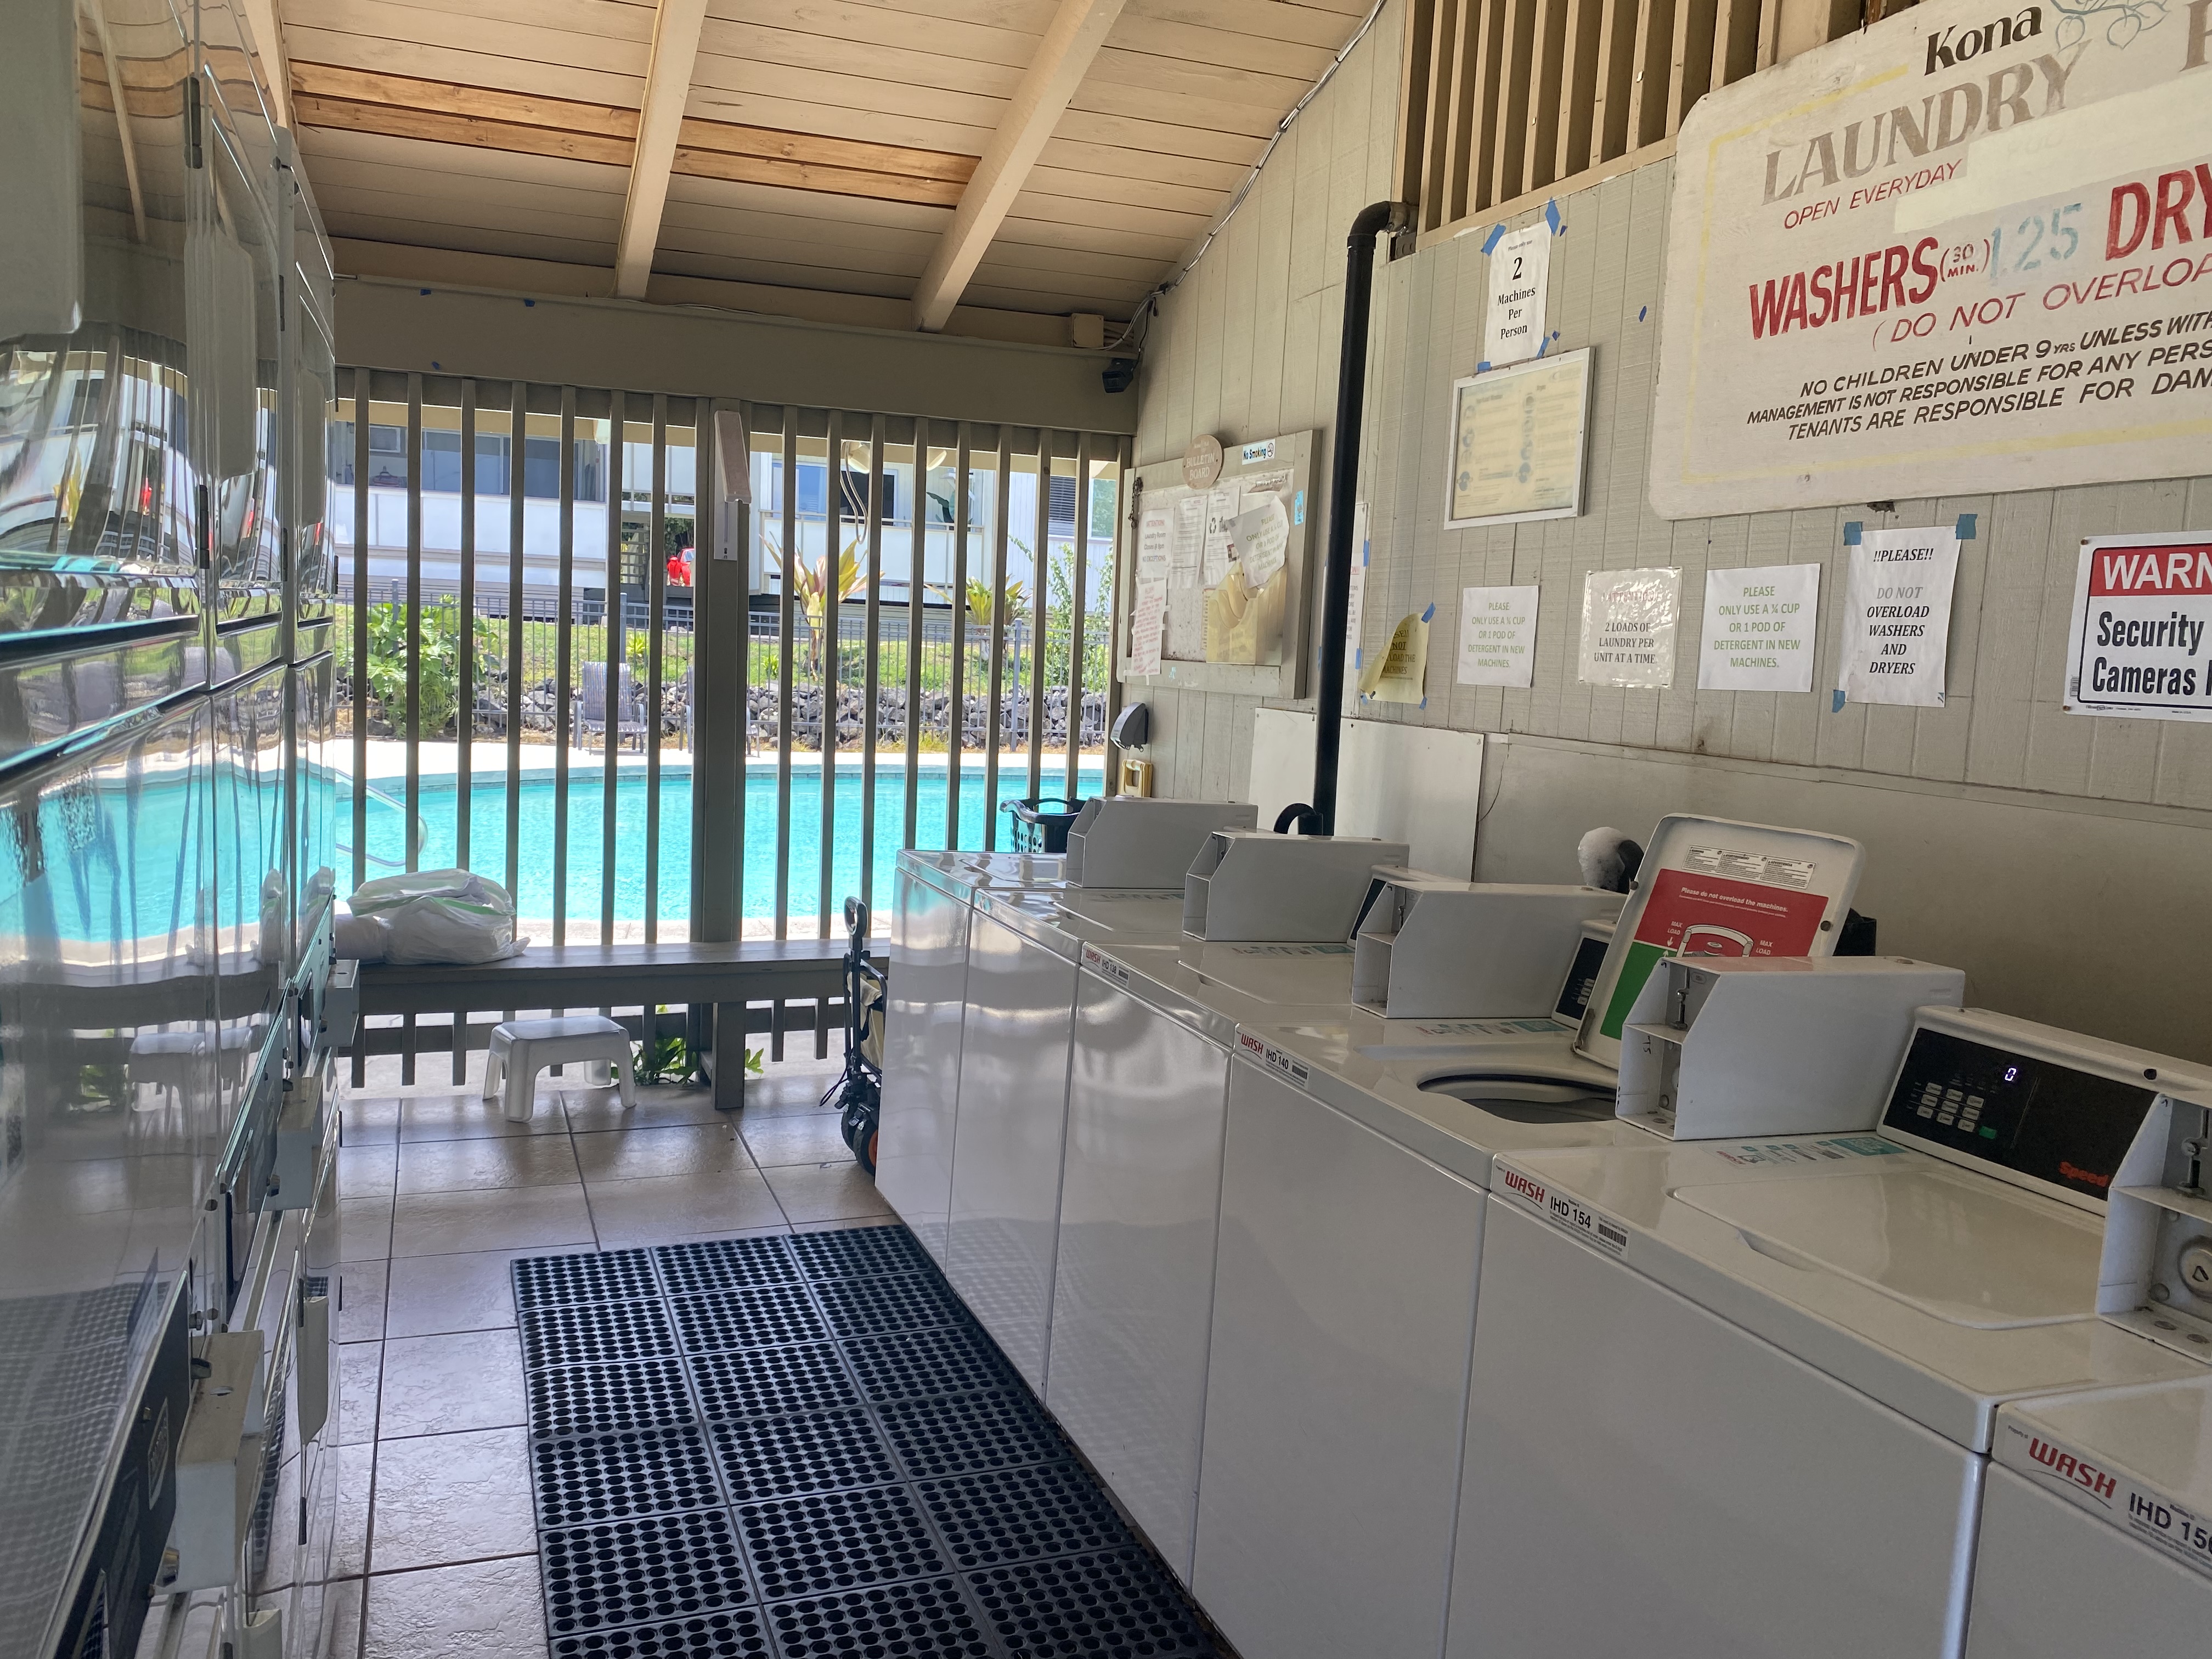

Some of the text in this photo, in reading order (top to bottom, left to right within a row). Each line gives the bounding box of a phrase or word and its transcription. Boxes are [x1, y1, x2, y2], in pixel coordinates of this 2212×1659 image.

[1924, 6, 2043, 76] Kona
[1762, 39, 2092, 205] LAUNDRY
[1784, 159, 1962, 229] OPEN EVERYDAY
[1512, 257, 1522, 280] 2
[1749, 236, 1938, 340] WASHERS
[1497, 287, 1536, 306] Machines
[1509, 308, 1522, 320] Per
[1950, 292, 2026, 330] NOT
[1500, 324, 1527, 340] Person
[1800, 380, 1827, 397] NO
[1833, 358, 1944, 391] CHILDREN
[1951, 344, 2029, 371] UNDER
[2036, 340, 2051, 358] 9
[2053, 342, 2075, 354] YRS
[2080, 320, 2163, 349] UNLESS
[1747, 339, 2212, 424] MANAGEMENT IS NOT RESPONSIBLE FOR ANY PERS
[1789, 415, 1863, 441] TENANTS
[1866, 409, 1906, 430] ARE
[1914, 387, 2065, 424] RESPONSIBLE
[2079, 378, 2134, 403] FOR
[1243, 447, 1266, 460] No Smoking
[1186, 453, 1215, 468] BULLETIN
[1189, 467, 1210, 480] BOARD
[1874, 548, 1934, 562] !!PLEASE!!
[1743, 586, 1775, 597] PLEASE
[1877, 586, 1923, 599] DO NOT
[1488, 602, 1510, 611] PLEASE
[1719, 605, 1741, 615] ONLY
[1744, 604, 1760, 614] USE
[1762, 604, 1769, 614] A
[1781, 603, 1800, 613] CUP
[1867, 606, 1929, 618] OVERLOAD
[1513, 617, 1525, 625] CUP
[1605, 623, 1651, 632] 2 LOADS OF
[1729, 622, 1786, 632] OR 1 POD OF
[1508, 631, 1515, 639] OF
[1869, 624, 1925, 637] WASHERS
[2097, 611, 2205, 656] Security
[1392, 641, 1407, 650] NOT
[1468, 644, 1501, 653] DETERGENT
[1510, 645, 1525, 653] NEW
[1599, 637, 1654, 647] LAUNDRY PER
[1714, 639, 1801, 650] DETERGENT IN NEW
[1881, 643, 1907, 655] AND
[1405, 654, 1415, 662] THE
[1477, 658, 1510, 668] MACHINES.
[1594, 652, 1613, 662] UNIT
[1615, 653, 1626, 663] AT
[1627, 653, 1632, 663] A
[1730, 657, 1779, 668] MACHINES.
[1383, 665, 1408, 675] MACHINES
[1869, 662, 1916, 674] DRYERS
[2092, 657, 2197, 696] Cameras
[1681, 887, 1699, 895] Please
[1719, 895, 1745, 904] overload
[1756, 902, 1788, 912] machines.
[1086, 949, 1101, 964] WASH
[1241, 1034, 1263, 1054] WASH
[1266, 1048, 1289, 1070] IHD 140
[2005, 1068, 2017, 1081] 0
[2059, 1161, 2109, 1188] Speed
[1505, 1171, 1545, 1203] WASH
[1550, 1196, 1569, 1216] IHD
[1573, 1209, 1591, 1228] 154
[2029, 1437, 2117, 1499] WASH
[2129, 1492, 2171, 1529] IHD
